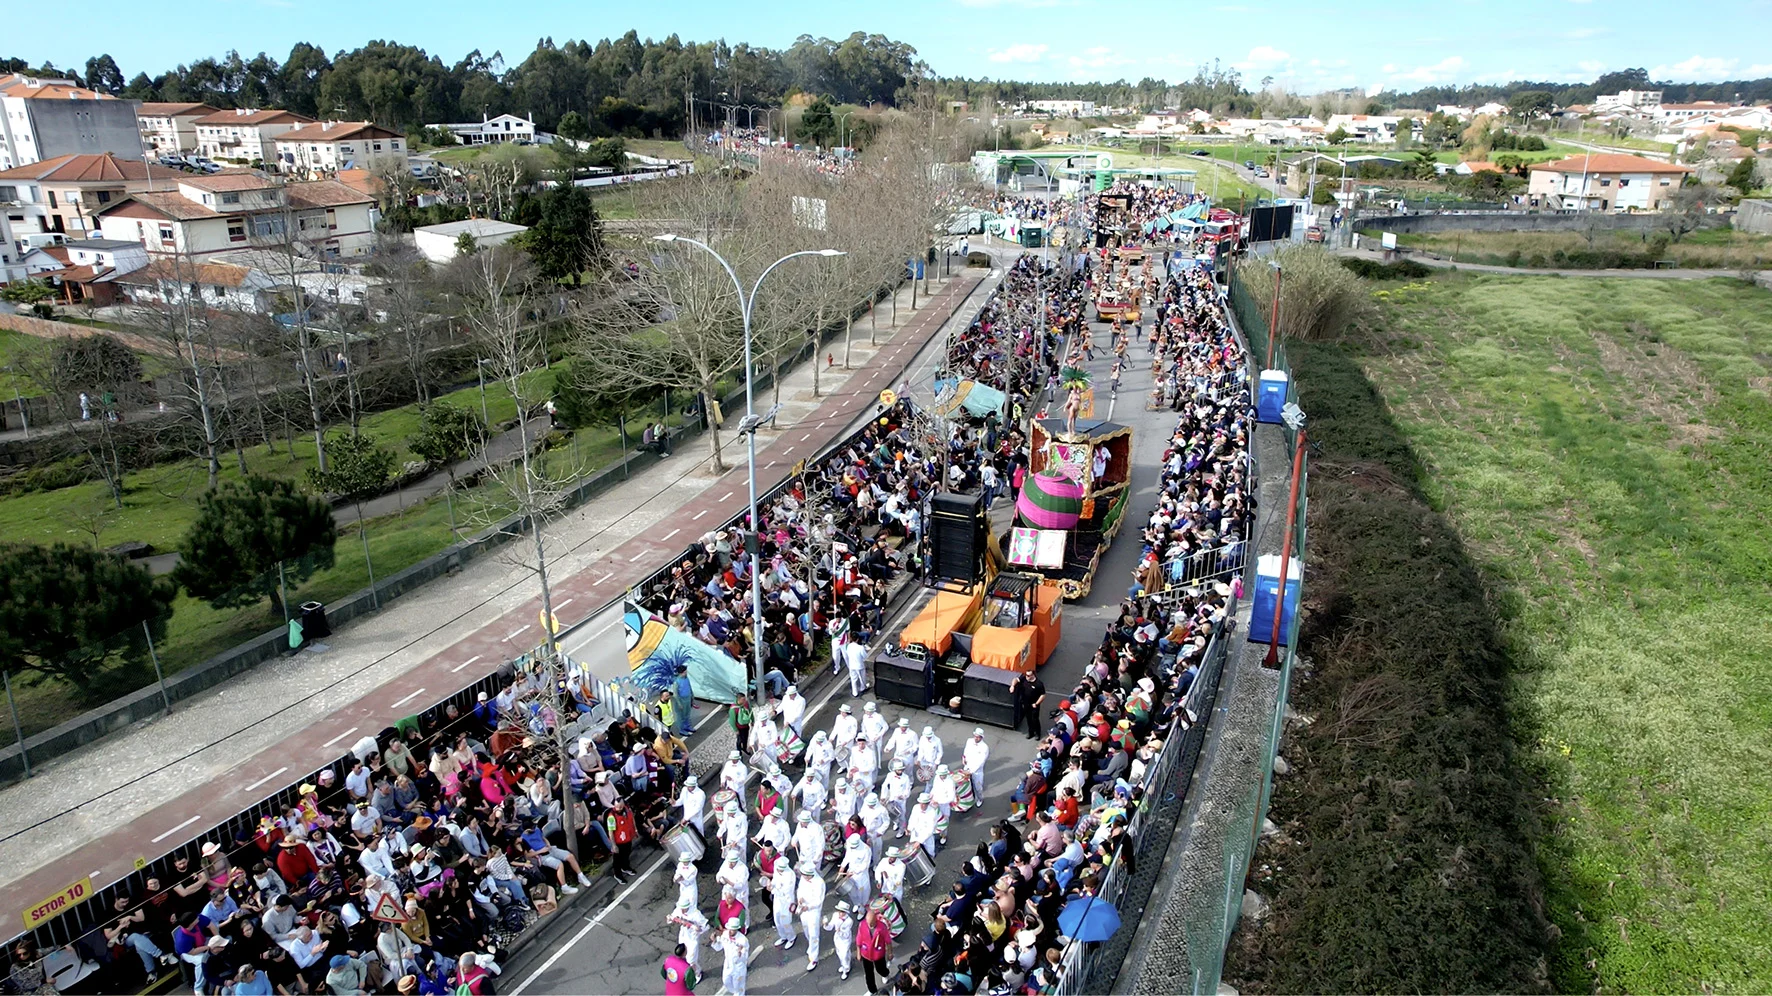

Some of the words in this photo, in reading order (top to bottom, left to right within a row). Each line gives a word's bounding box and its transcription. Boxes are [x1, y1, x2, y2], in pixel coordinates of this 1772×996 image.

[136, 858, 144, 867] 20
[31, 895, 66, 921] SETOR
[66, 883, 84, 900] 10
